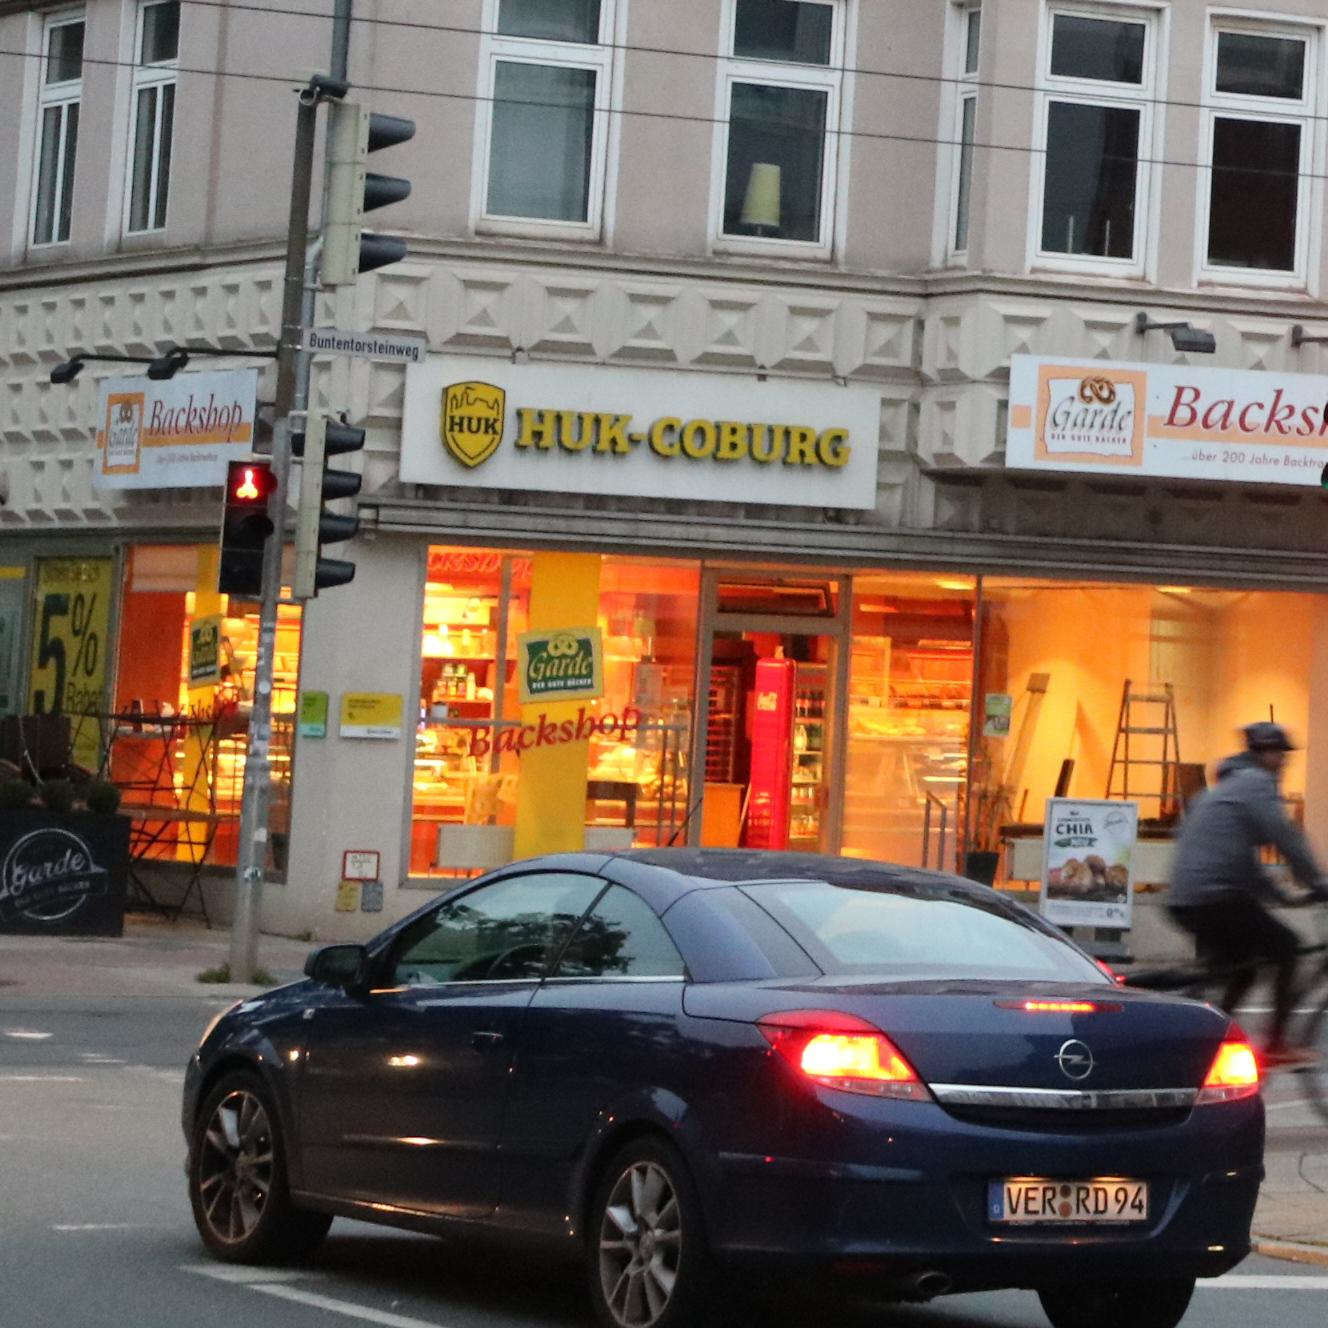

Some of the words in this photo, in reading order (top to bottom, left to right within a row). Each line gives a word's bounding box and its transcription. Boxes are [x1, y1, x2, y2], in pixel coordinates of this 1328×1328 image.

[309, 333, 420, 360] Buntentorsteinweg
[150, 393, 243, 443] Backshop
[448, 415, 499, 436] HUK
[1051, 395, 1132, 432] Garde
[515, 407, 852, 468] HUK-COBURG
[1222, 450, 1245, 463] 200
[1249, 452, 1280, 467] Jahre
[1284, 454, 1328, 469] Backtra
[529, 652, 593, 680] Garde
[469, 706, 642, 758] Backshop
[1056, 823, 1094, 835] CHIA
[1007, 1185, 1057, 1215] VER
[1076, 1185, 1108, 1215] RD
[1115, 1185, 1144, 1215] 94
